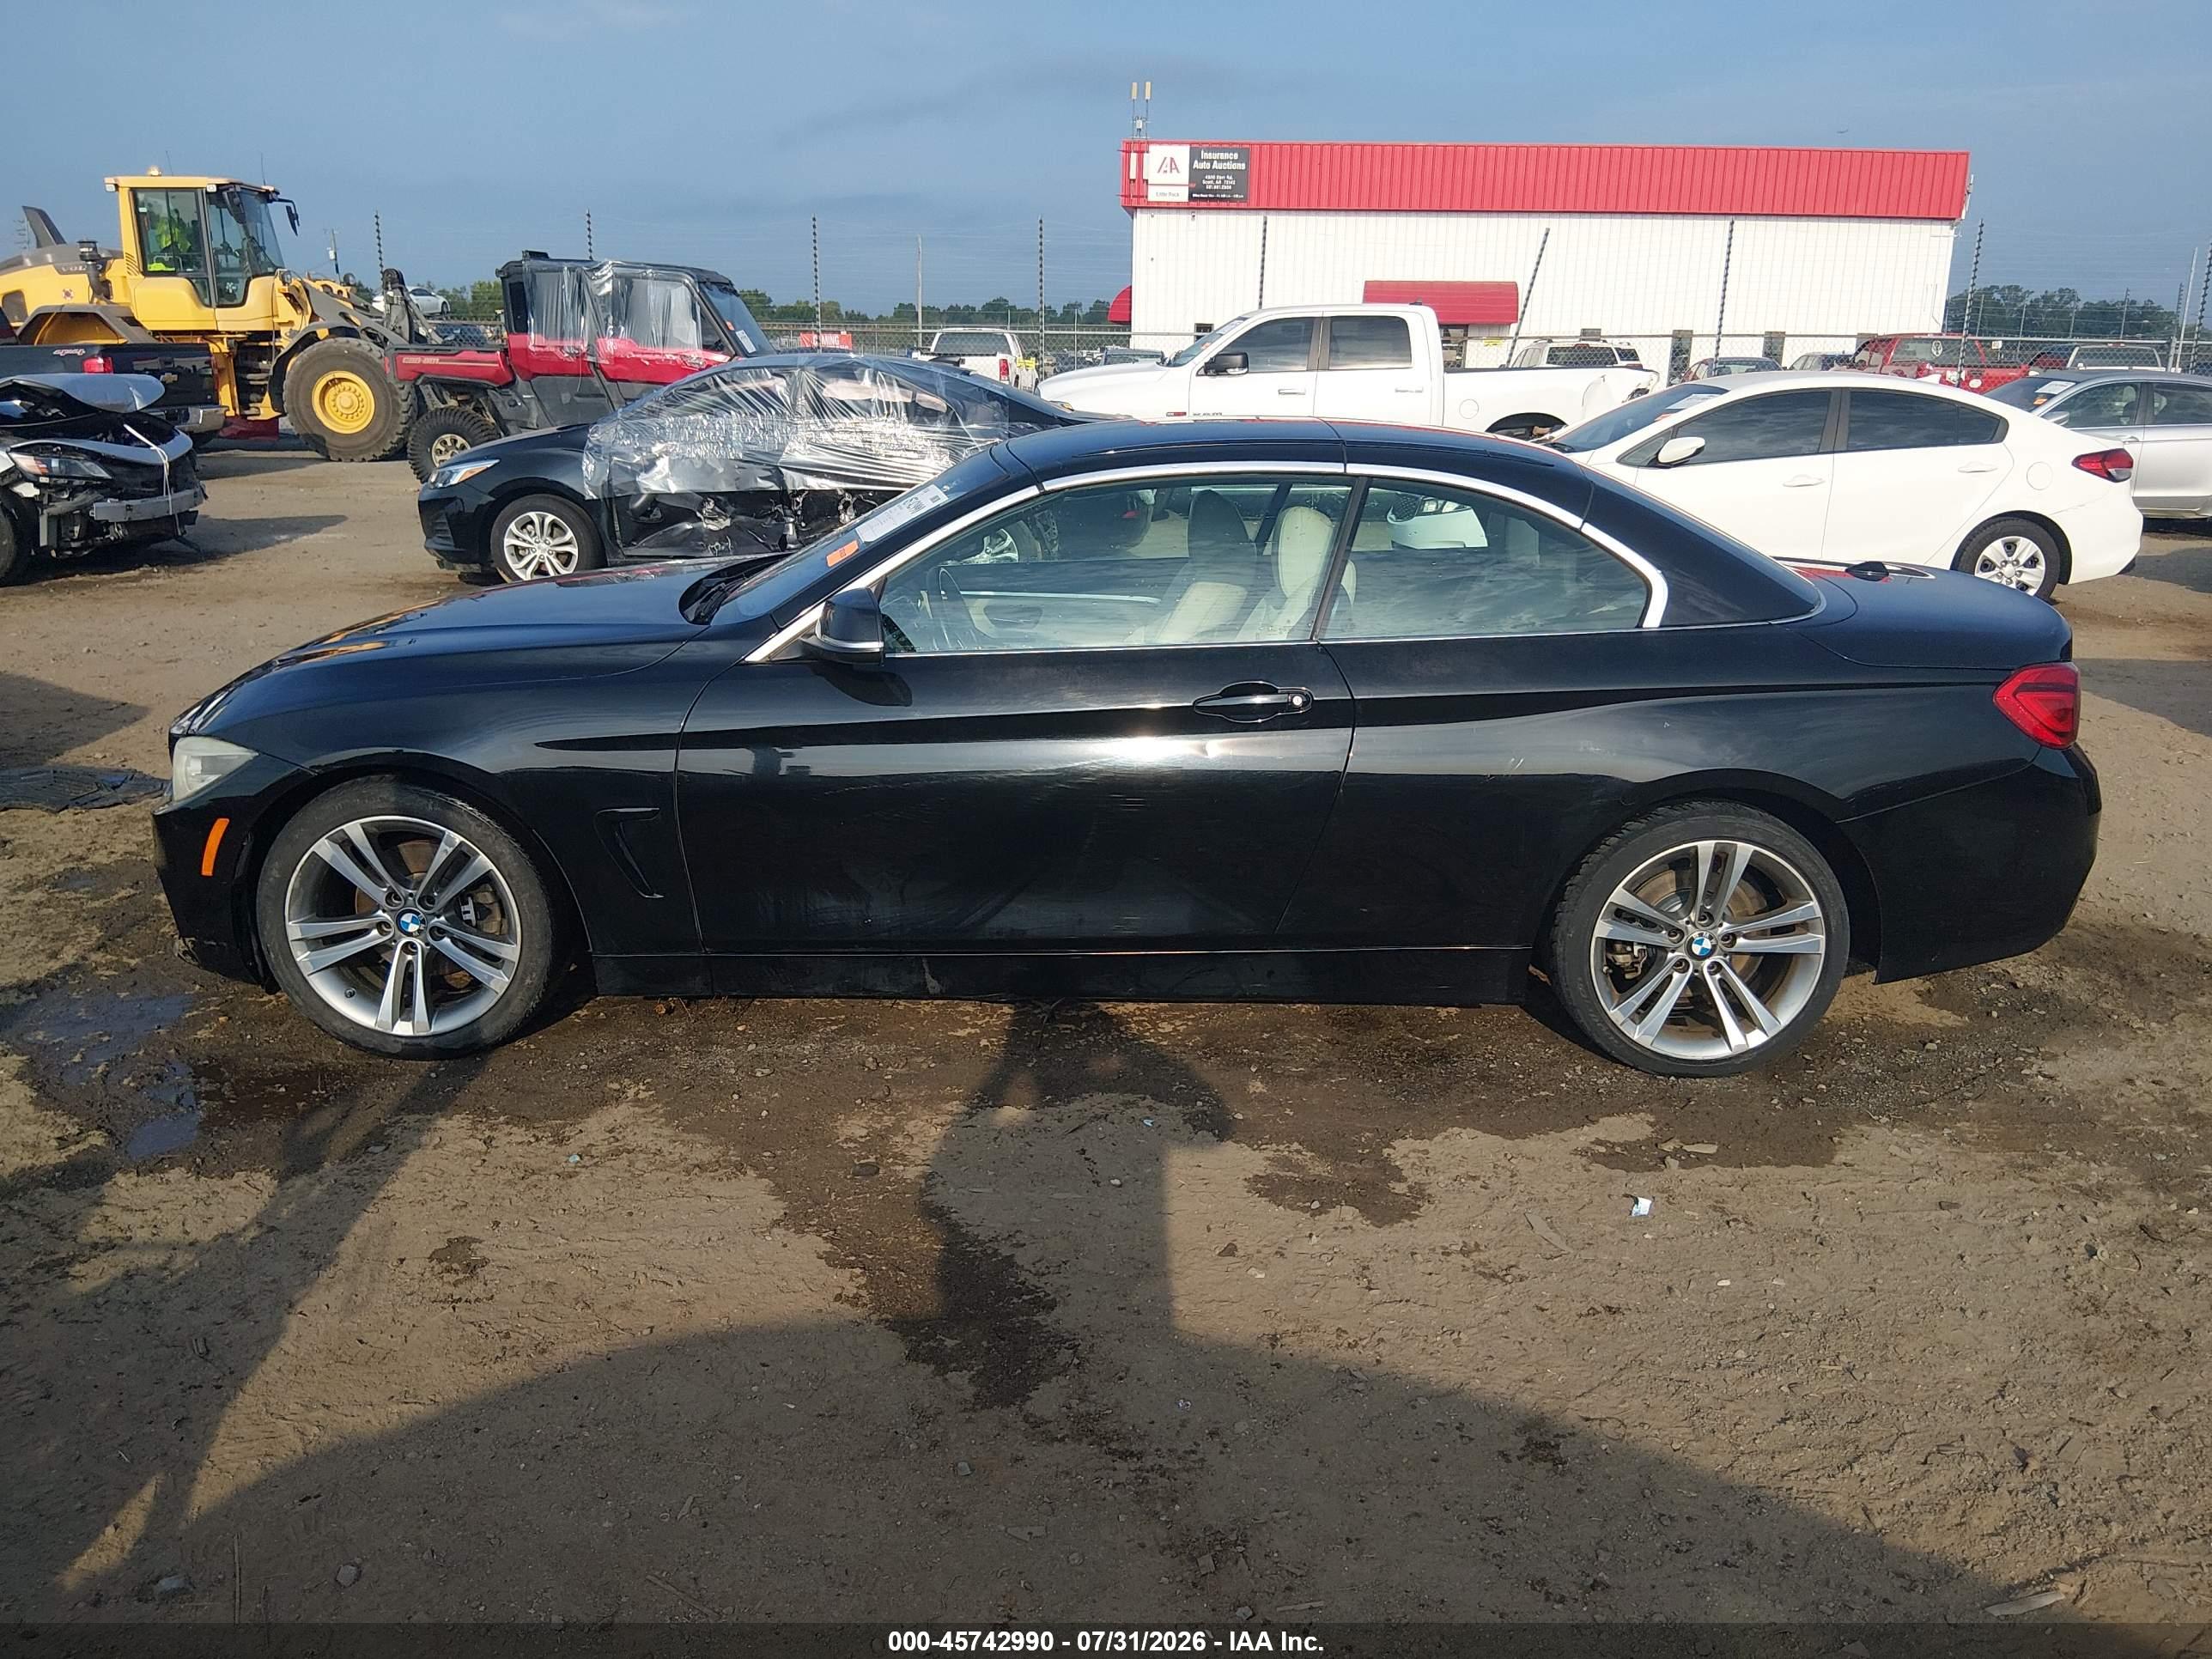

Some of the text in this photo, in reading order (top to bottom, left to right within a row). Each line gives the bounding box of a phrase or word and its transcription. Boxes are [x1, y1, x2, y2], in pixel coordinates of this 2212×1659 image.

[1200, 149, 1239, 160] Insurance
[1193, 160, 1246, 170] Auto Auctions
